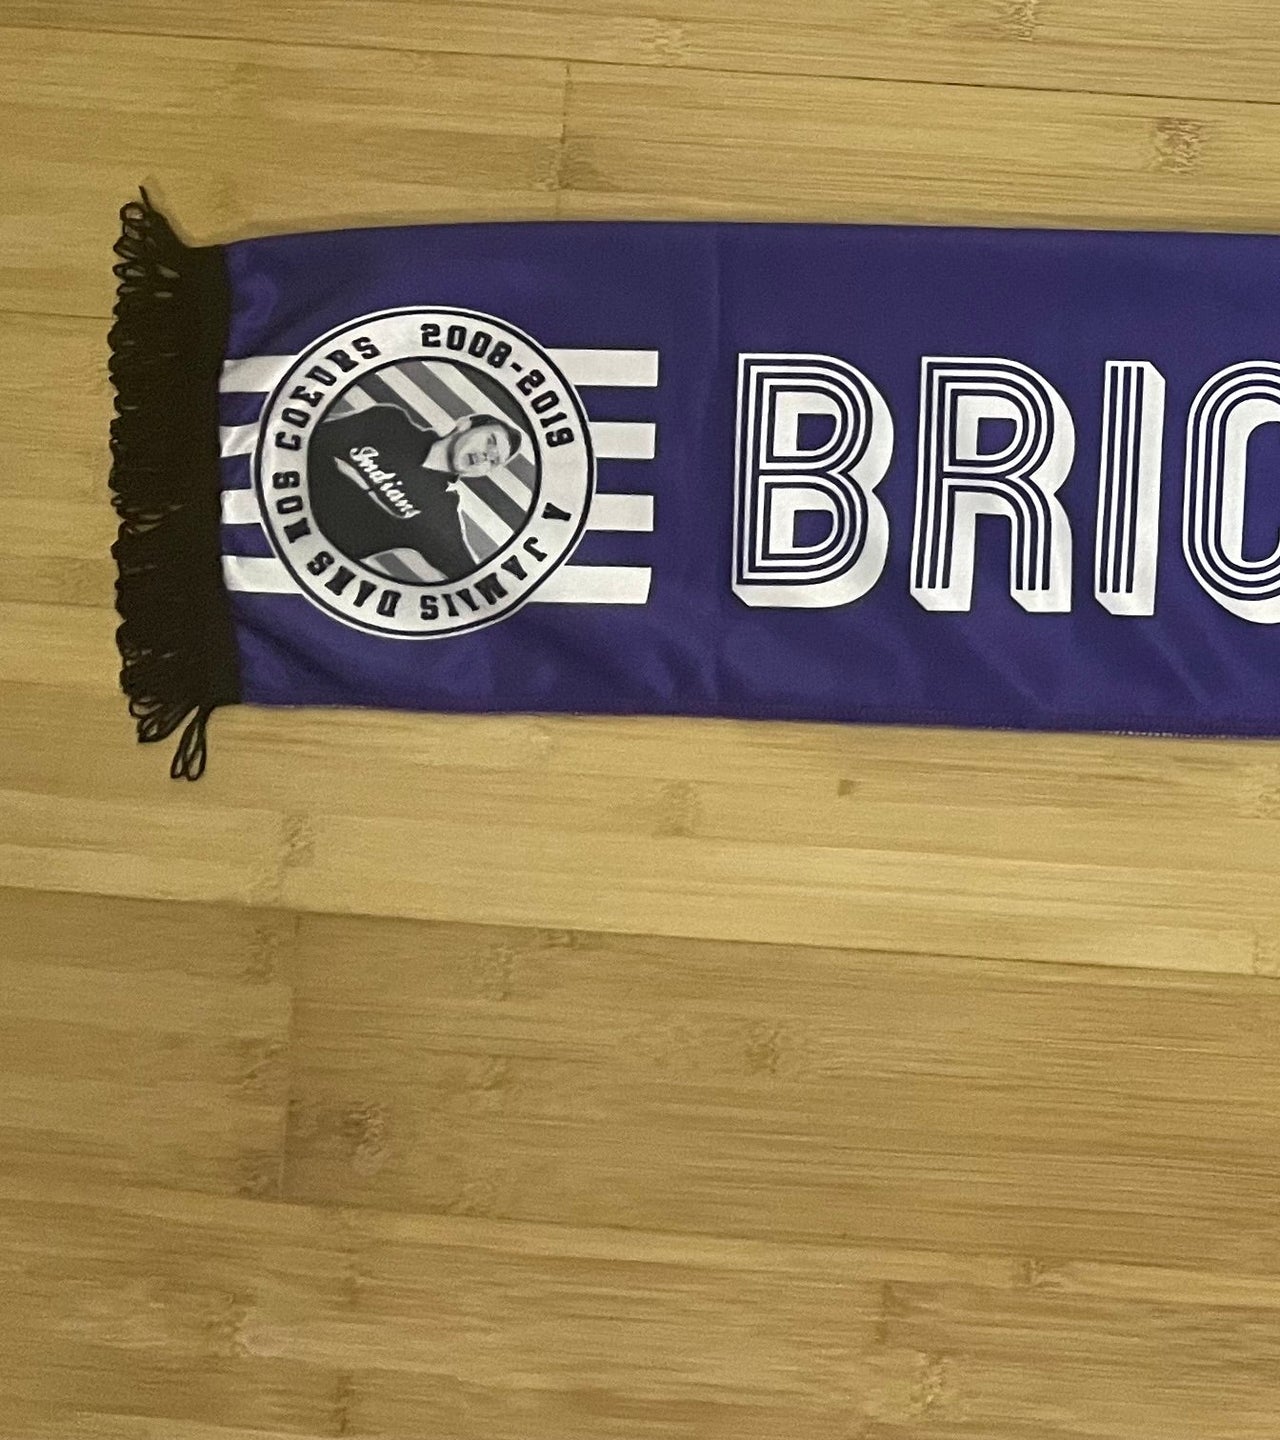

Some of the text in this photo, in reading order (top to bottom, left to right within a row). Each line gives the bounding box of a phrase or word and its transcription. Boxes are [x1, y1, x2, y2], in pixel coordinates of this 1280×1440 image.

[273, 323, 574, 620] A JAMAIS DANS NOS COEURS 2008-2019
